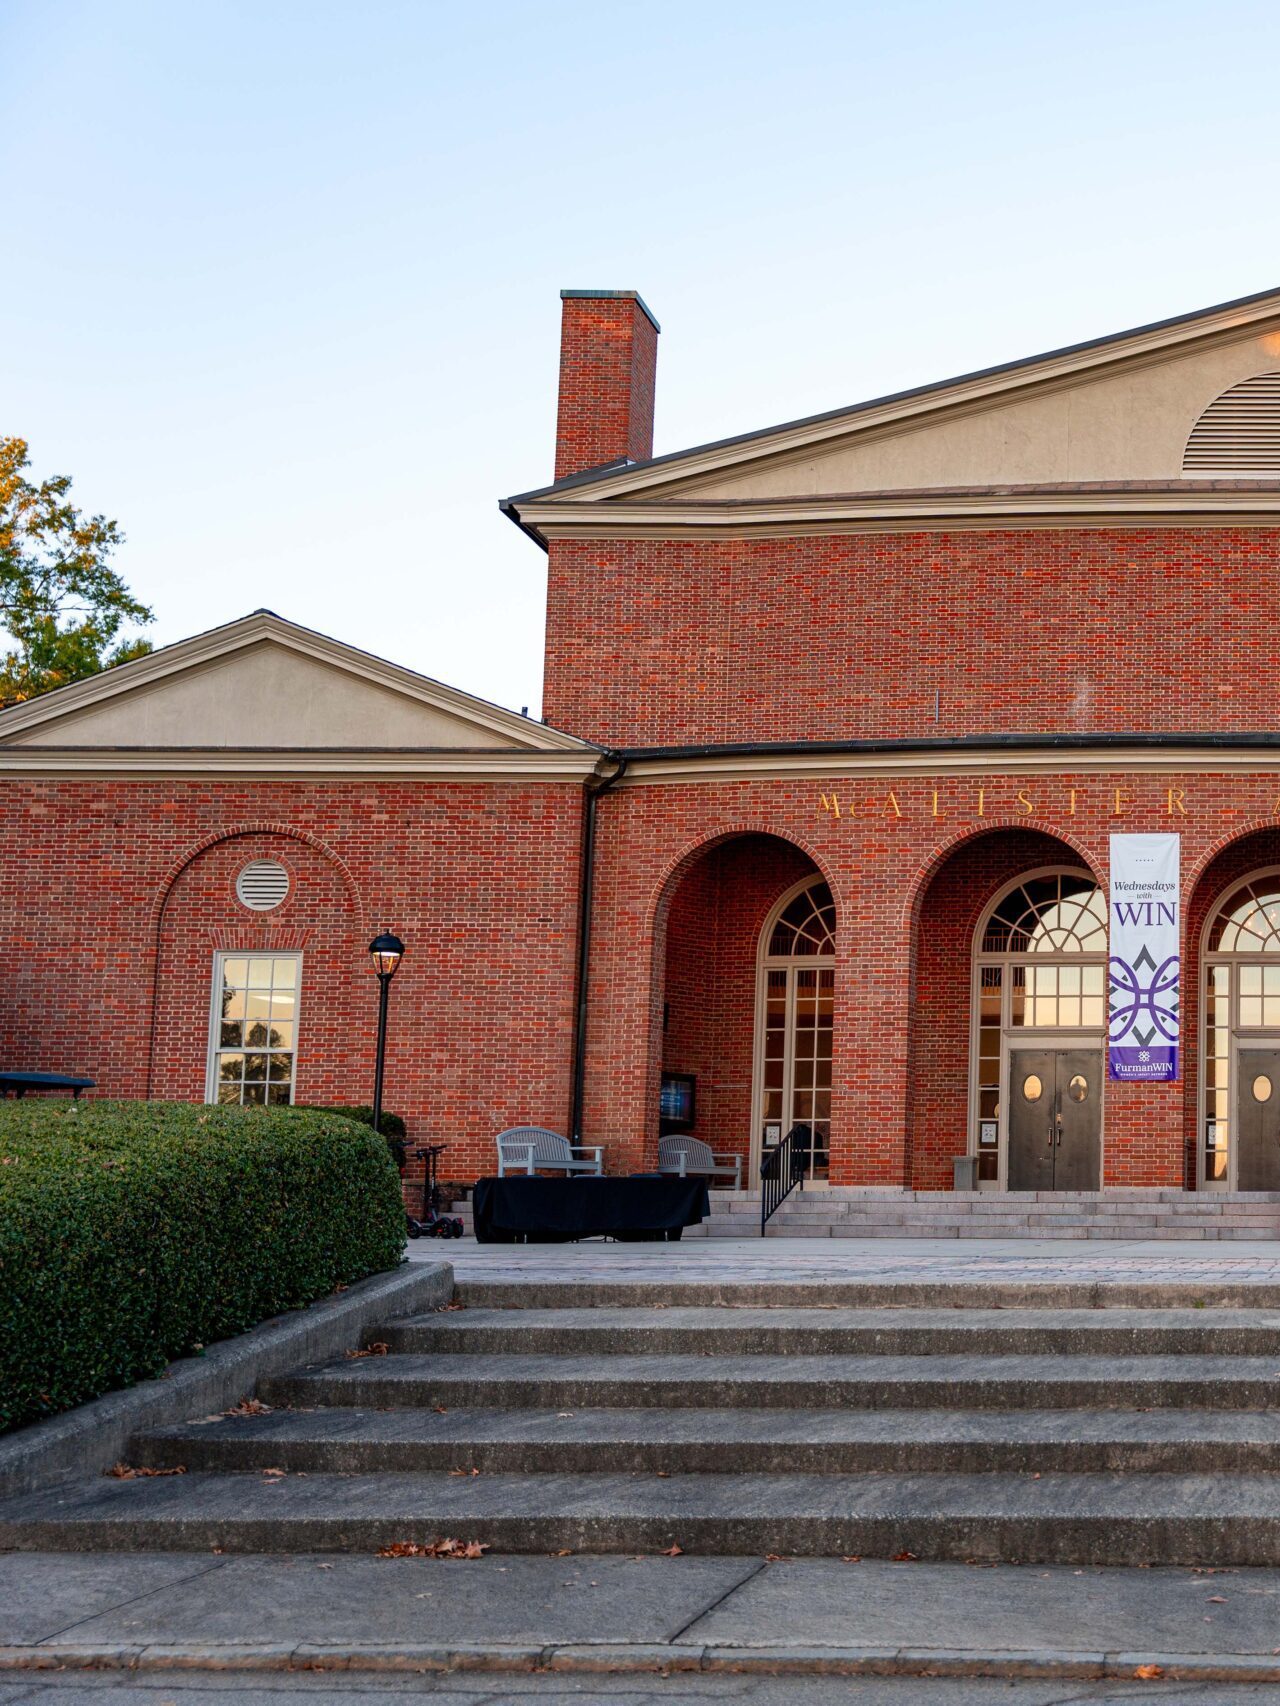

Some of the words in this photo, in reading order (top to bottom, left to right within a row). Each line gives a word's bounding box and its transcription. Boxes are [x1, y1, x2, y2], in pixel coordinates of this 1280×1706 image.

[815, 788, 1189, 819] McALISTER
[1114, 881, 1176, 892] Wednesdays
[1112, 902, 1177, 927] WIN
[1115, 1062, 1173, 1072] FurmanWIN
